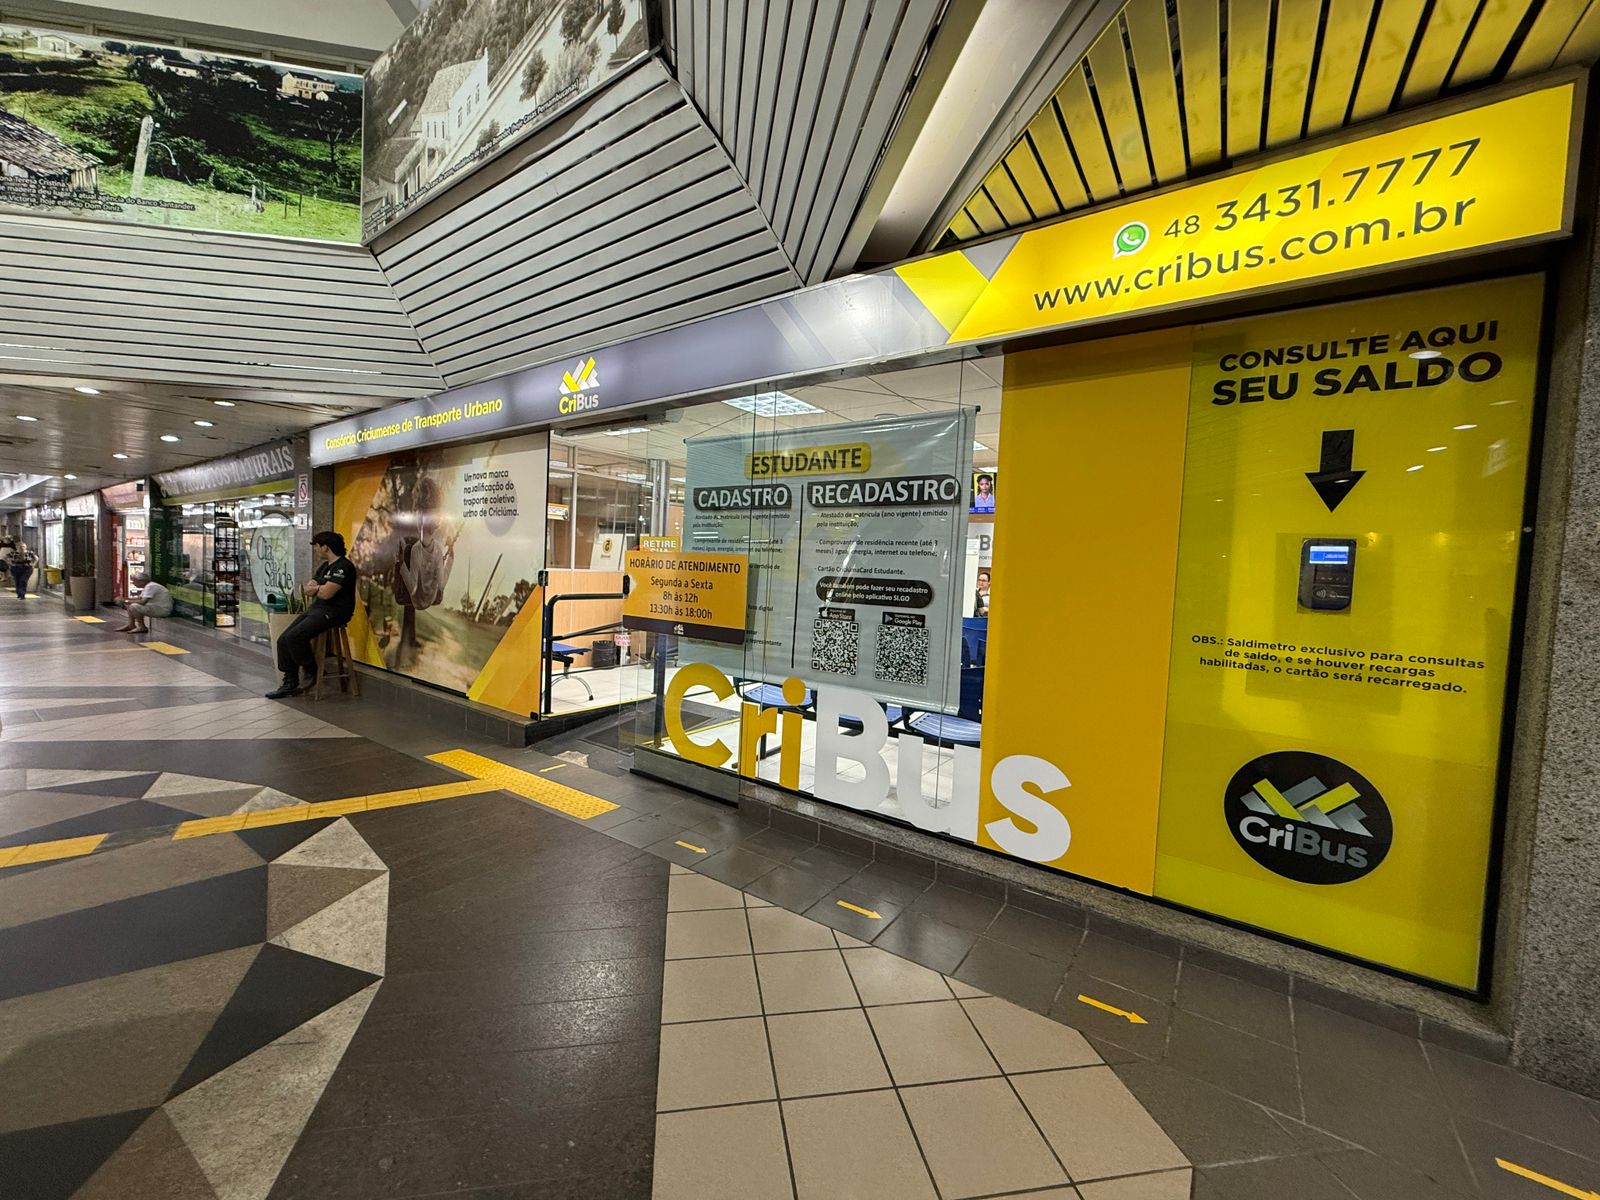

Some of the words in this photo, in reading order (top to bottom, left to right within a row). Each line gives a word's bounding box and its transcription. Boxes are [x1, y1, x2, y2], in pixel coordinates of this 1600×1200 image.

[15, 176, 37, 184] Teresa
[1164, 214, 1200, 238] 48
[1214, 137, 1481, 232] 3431.7777
[7, 186, 36, 194] madeira
[53, 189, 71, 198] lugar
[137, 198, 157, 206] Banco
[160, 200, 195, 210] Santander.
[1033, 196, 1477, 311] www.cribus.com.br
[1219, 334, 1389, 372] CONSULTE
[1400, 320, 1499, 352] AQUI
[1211, 372, 1299, 406] SEU
[1312, 351, 1503, 397] SALDO
[559, 393, 599, 415] CriBus
[325, 432, 356, 450] Consórcio
[402, 418, 413, 433] de
[414, 407, 462, 430] Transporte
[464, 398, 503, 418] Urbano
[230, 446, 295, 482] NATURAIS
[752, 447, 862, 476] ESTUDANTE
[489, 470, 509, 479] marca
[505, 480, 514, 490] do
[811, 477, 960, 505] RECADASTRO
[490, 493, 515, 504] coletivo
[698, 486, 788, 508] CADASTRO
[479, 507, 487, 517] de
[881, 510, 895, 518] (ano
[896, 509, 921, 518] vigente)
[922, 509, 948, 517] emitido
[257, 535, 274, 560] Cia
[643, 539, 677, 548] RETIRE
[864, 538, 894, 546] residência
[919, 539, 933, 547] (até
[874, 548, 899, 556] internet
[630, 556, 663, 570] HORÁRIO
[665, 560, 676, 570] DE
[678, 560, 741, 574] ATENDIMENTO
[873, 567, 905, 575] Estudante.
[650, 575, 682, 588] Segunda
[684, 579, 689, 587] a
[691, 578, 713, 590] Sexta
[896, 586, 928, 594] recadastro
[662, 590, 672, 601] 8h
[674, 591, 682, 602] às
[684, 592, 698, 603] 12h
[852, 592, 864, 600] pelo
[865, 594, 892, 602] aplicativo
[649, 603, 673, 615] 13:30h
[674, 606, 683, 616] às
[685, 607, 713, 620] 18:00h
[894, 618, 911, 626] Google
[1191, 634, 1224, 646] OBS.:
[1227, 638, 1296, 652] Saldimetro
[1300, 645, 1366, 659] exclusivo
[1370, 650, 1403, 662] para
[1408, 655, 1485, 669] consultas
[1224, 649, 1240, 658] de
[1243, 650, 1281, 663] saldo,
[1285, 655, 1293, 663] e
[1297, 655, 1312, 665] se
[1316, 657, 1365, 670] houver
[1369, 663, 1436, 677] recargas
[1199, 656, 1269, 673] habilitadas,
[1273, 665, 1282, 673] o
[1285, 665, 1329, 679] cartão
[1332, 671, 1363, 682] será
[1367, 674, 1468, 694] recarregado.
[664, 662, 1072, 863] CriBus
[1238, 814, 1368, 869] CriBus
